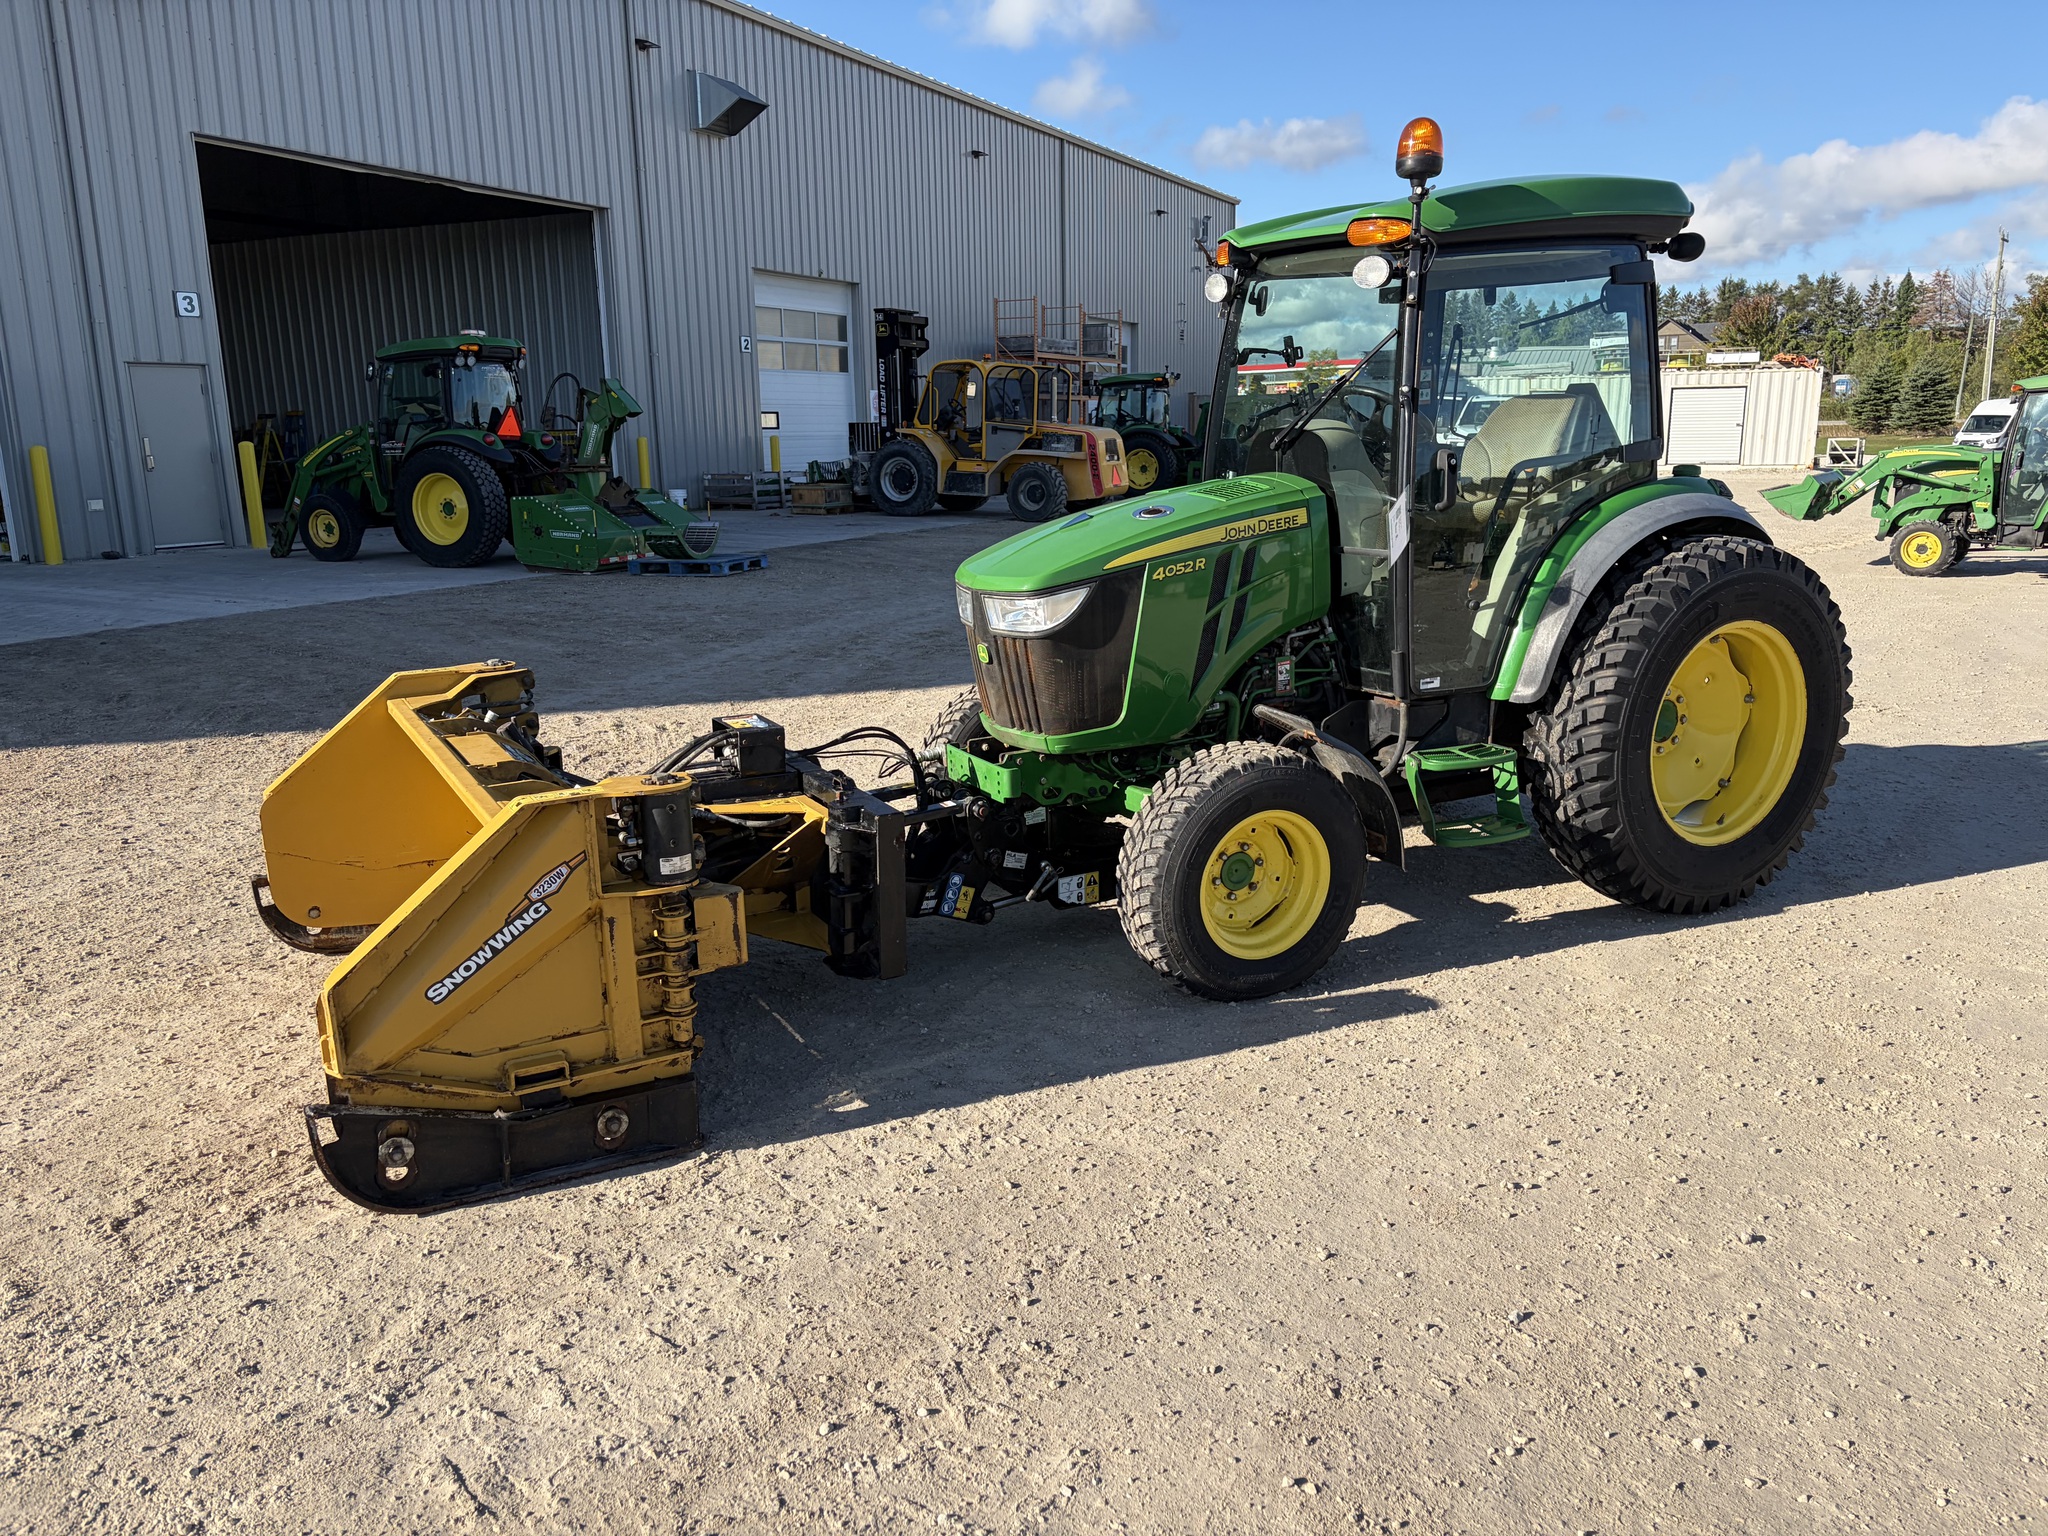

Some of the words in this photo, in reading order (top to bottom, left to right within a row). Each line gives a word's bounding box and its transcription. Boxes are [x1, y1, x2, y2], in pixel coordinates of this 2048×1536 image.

[181, 295, 196, 314] 3
[743, 338, 750, 351] 2
[878, 358, 886, 382] LOAD
[879, 383, 887, 414] LIFTER
[1220, 523, 1256, 541] JOHN
[1258, 515, 1299, 534] DEERE
[533, 868, 566, 898] 3230W
